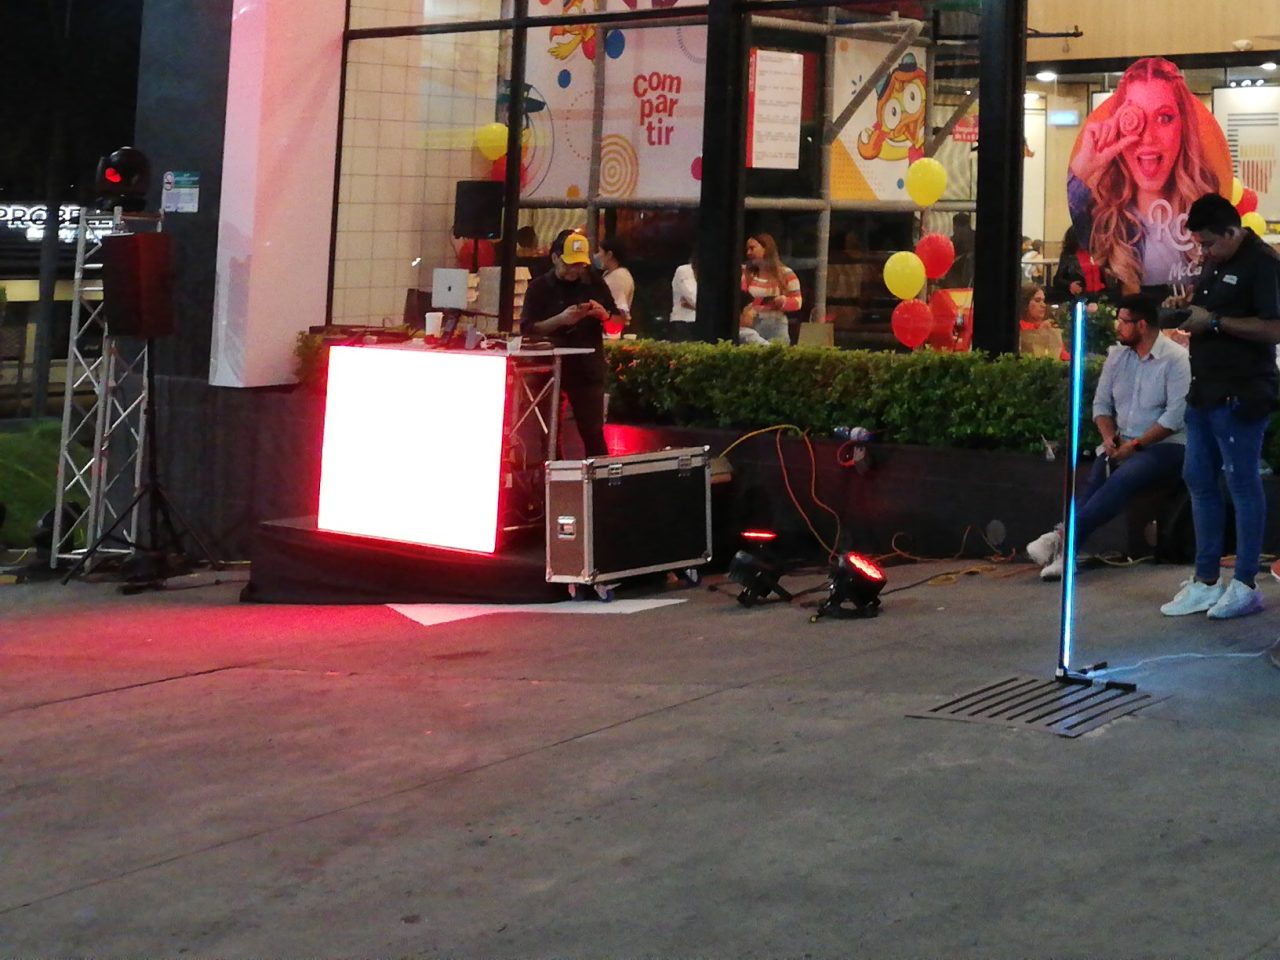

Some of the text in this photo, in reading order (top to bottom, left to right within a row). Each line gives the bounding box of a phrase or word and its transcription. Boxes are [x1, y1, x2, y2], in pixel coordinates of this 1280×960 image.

[633, 71, 682, 98] com
[640, 94, 679, 127] par
[646, 117, 675, 146] tir
